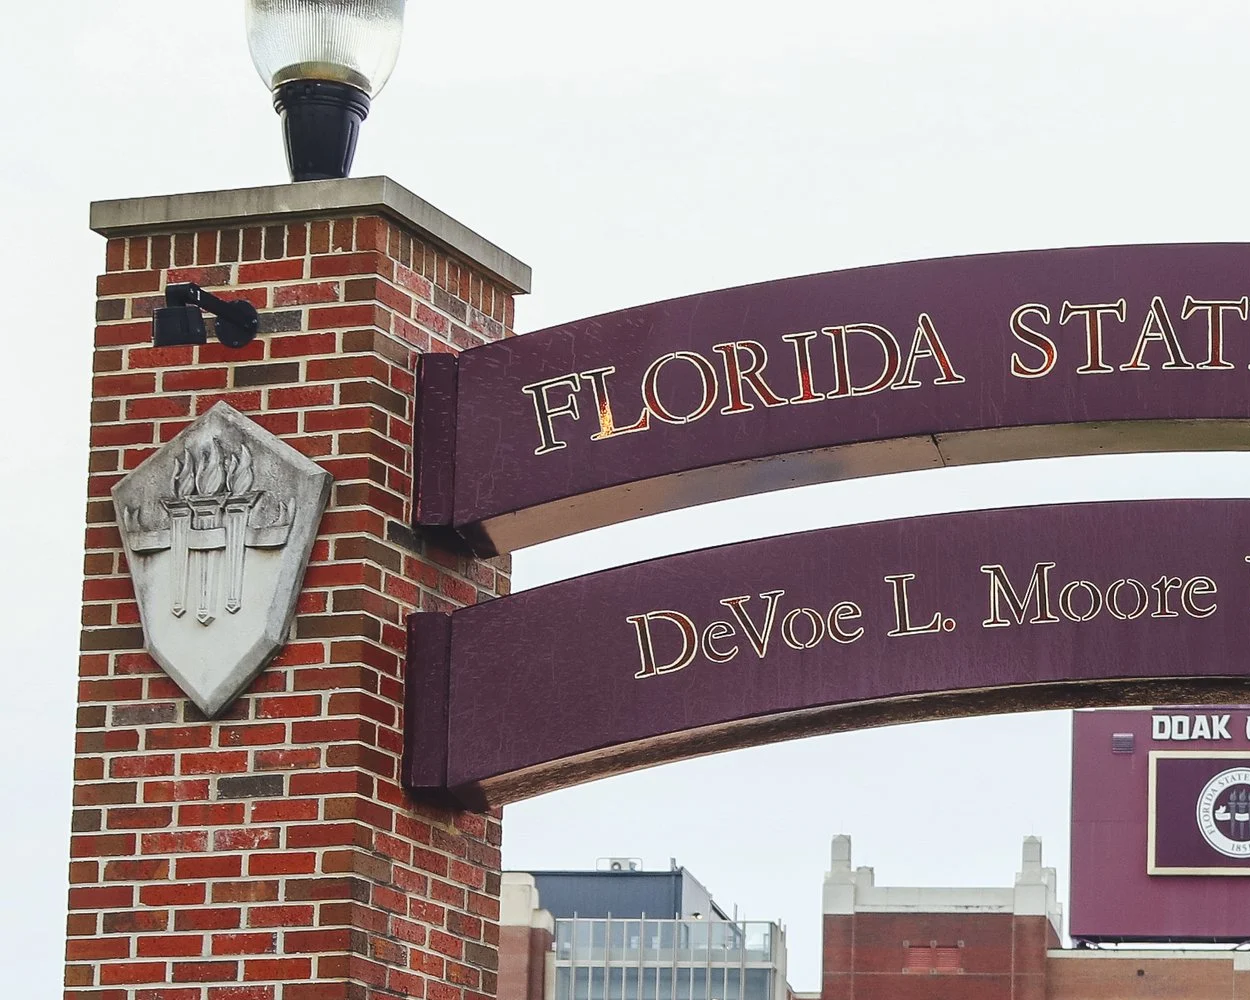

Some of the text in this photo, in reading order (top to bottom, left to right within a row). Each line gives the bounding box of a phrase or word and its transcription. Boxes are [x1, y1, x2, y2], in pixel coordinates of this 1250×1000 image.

[522, 312, 965, 455] FLORIDA
[626, 590, 864, 679] DeVoe
[885, 573, 956, 637] L.
[980, 562, 1217, 628] Moore
[1151, 714, 1232, 740] DOAK
[1202, 787, 1219, 836] FLORIDA
[1218, 772, 1250, 788] STATE
